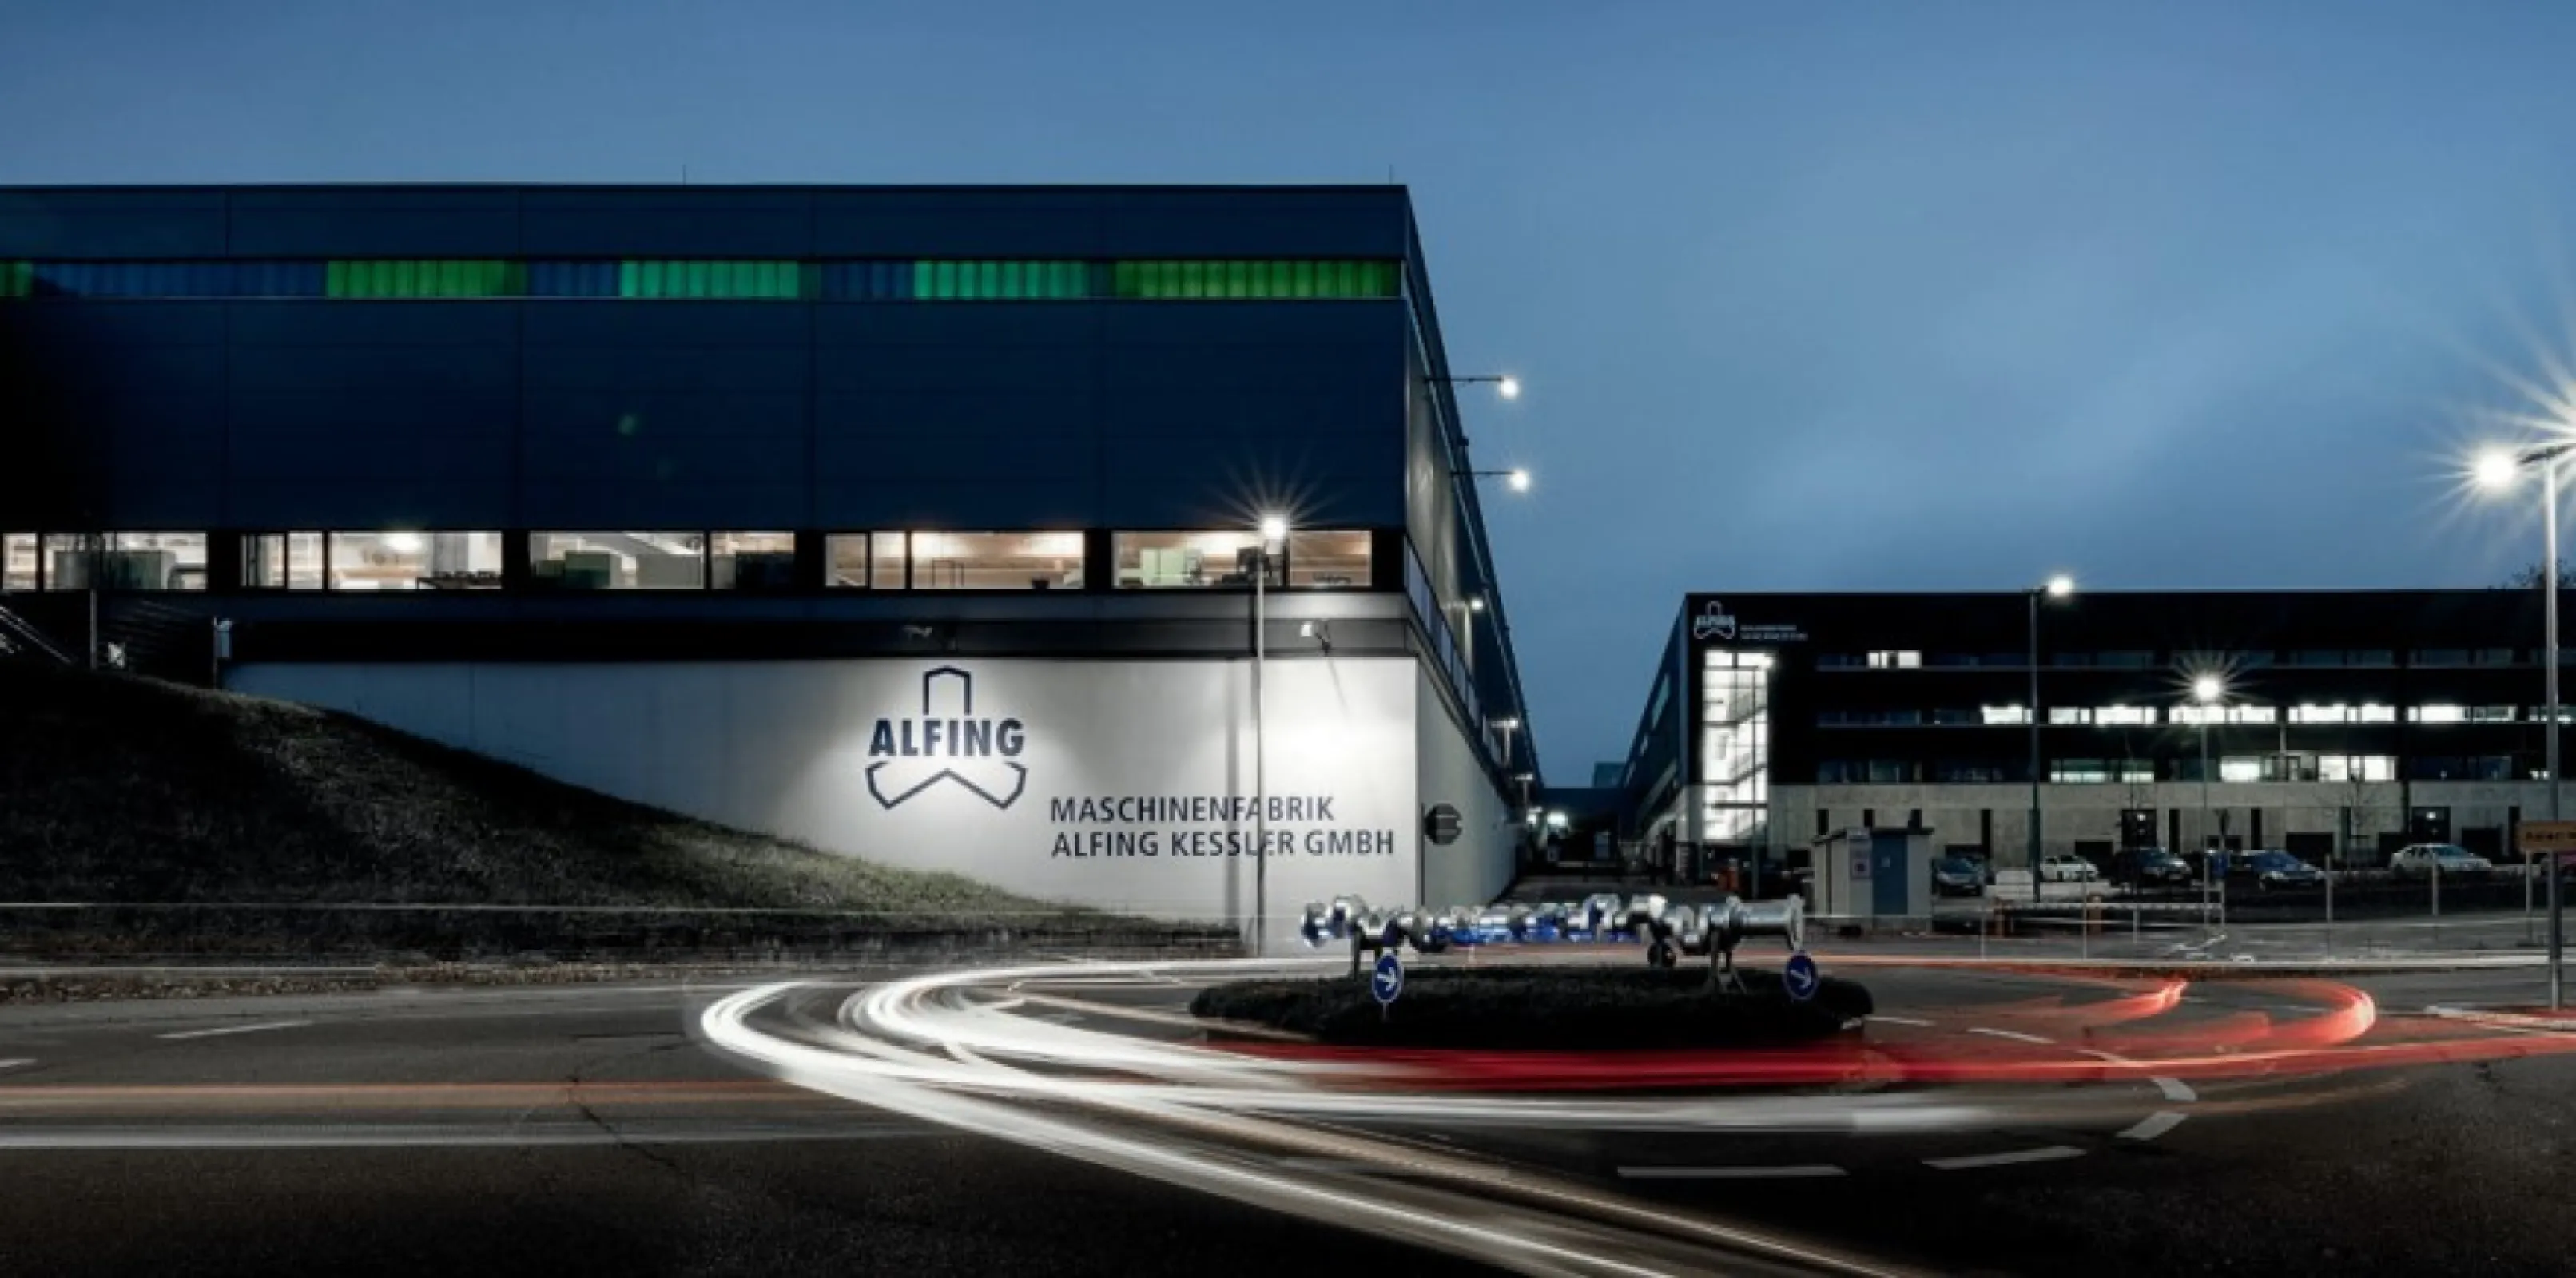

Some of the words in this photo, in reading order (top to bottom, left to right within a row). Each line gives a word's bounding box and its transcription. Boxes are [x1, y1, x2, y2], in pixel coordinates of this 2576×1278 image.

[869, 718, 1024, 756] ALFING
[1051, 796, 1334, 821] MASCHINENFABRIK
[1051, 831, 1159, 857] ALFING
[1171, 831, 1294, 857] KESSLER
[1305, 830, 1393, 856] GMBH
